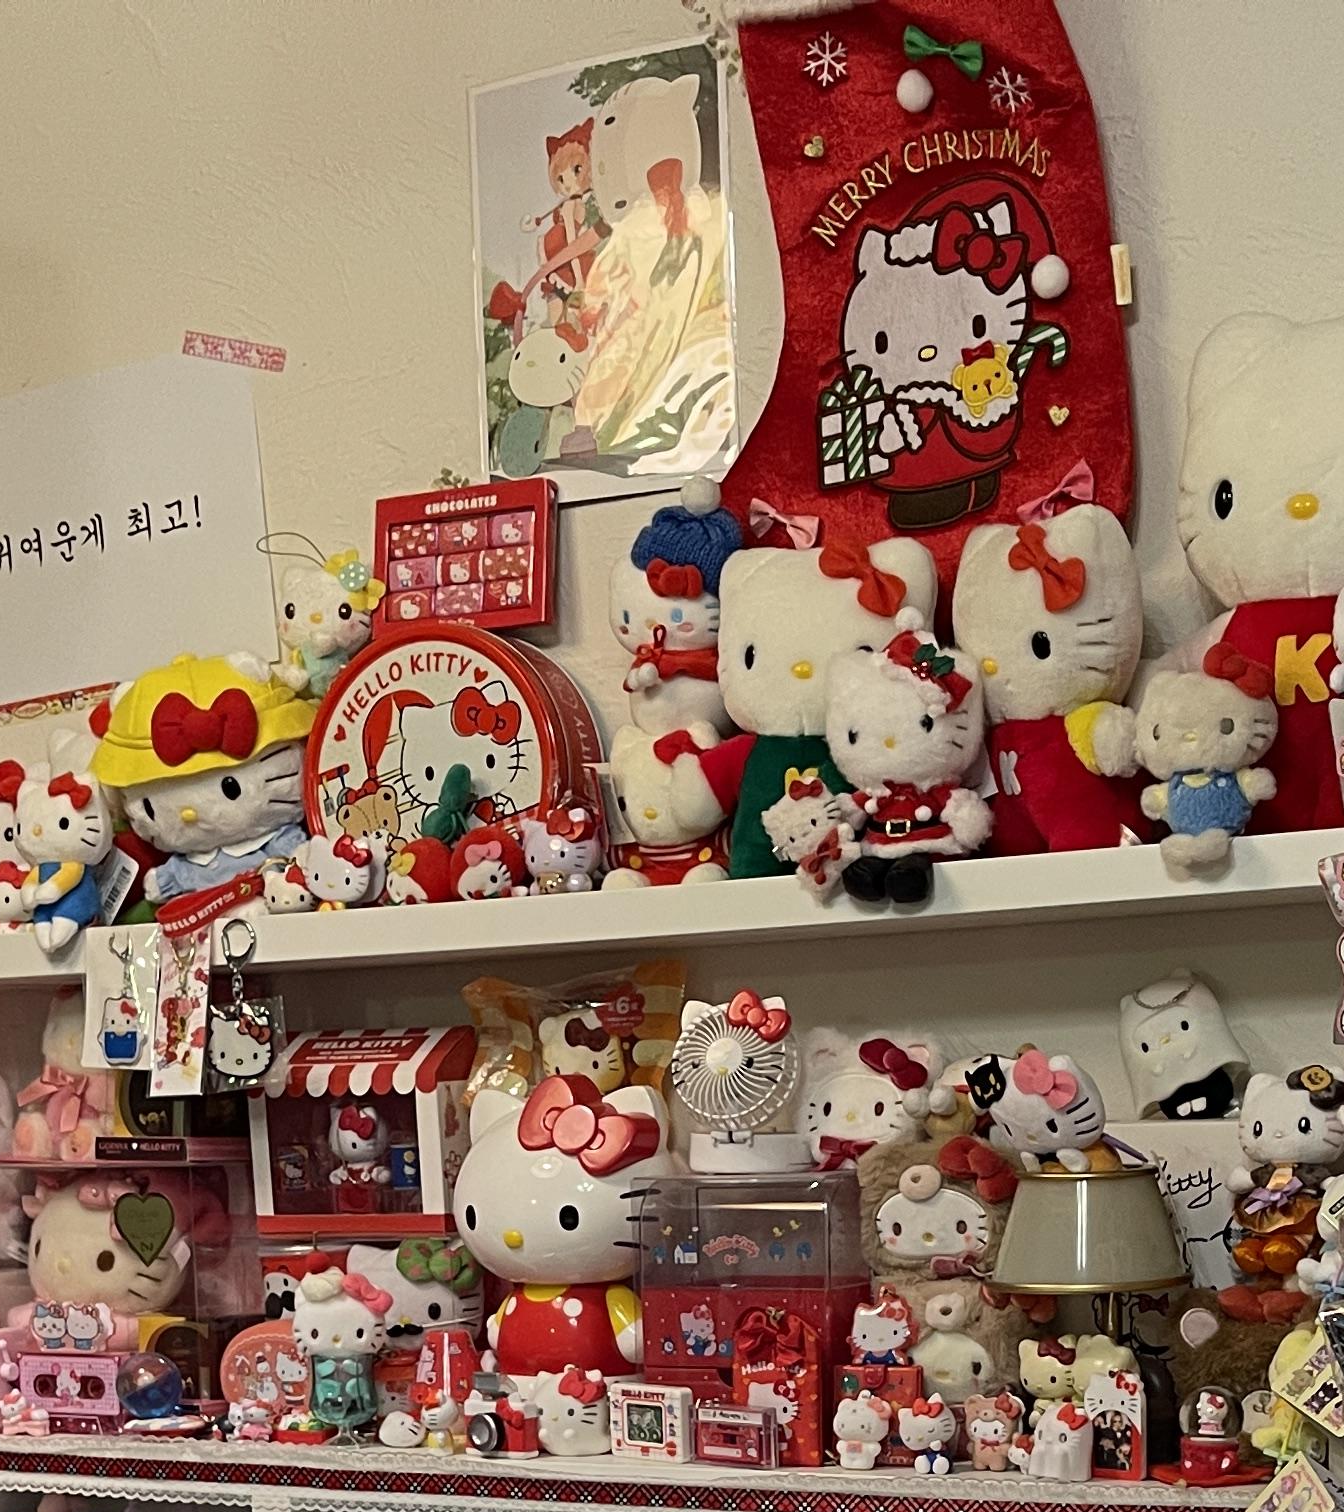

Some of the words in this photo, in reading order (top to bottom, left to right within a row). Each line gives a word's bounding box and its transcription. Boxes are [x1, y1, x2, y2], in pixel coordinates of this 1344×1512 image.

[811, 154, 894, 247] MERRY
[903, 128, 1051, 177] CHRISTMAS
[127, 494, 202, 543] 최고!
[424, 494, 498, 516] CHOCOLATES
[1274, 632, 1333, 706] K
[341, 661, 403, 724] HELLO
[410, 652, 472, 675] KITTY
[163, 913, 198, 932] HELLO
[197, 898, 223, 919] KITTY
[311, 1040, 361, 1050] HELLO
[361, 1038, 413, 1049] KITTY
[139, 1142, 160, 1151] HELLO
[161, 1142, 181, 1151] KITTY
[741, 1361, 776, 1375] Hello
